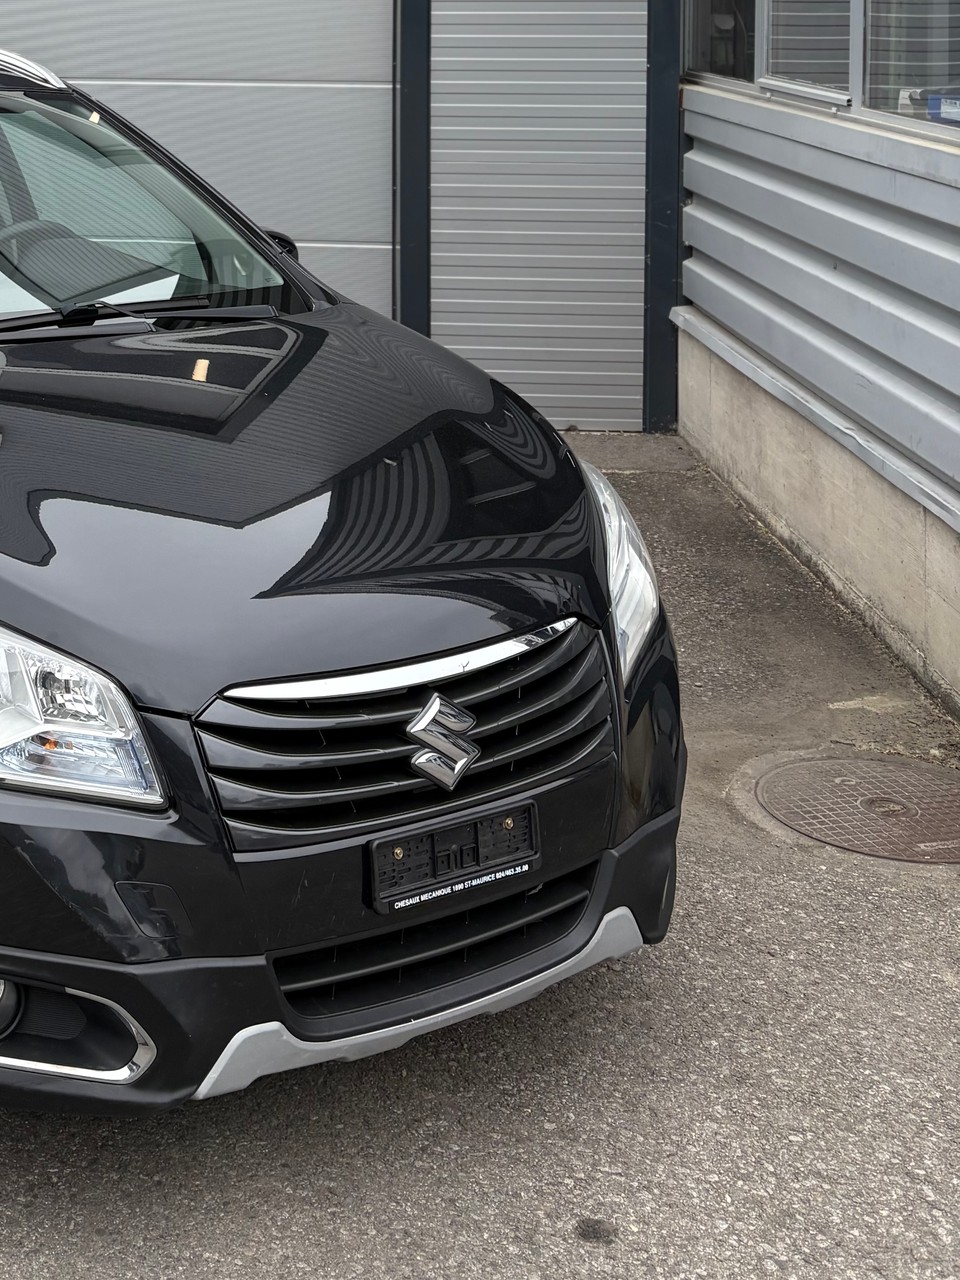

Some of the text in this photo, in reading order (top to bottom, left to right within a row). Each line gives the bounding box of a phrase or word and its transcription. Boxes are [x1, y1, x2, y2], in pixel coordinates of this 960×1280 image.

[394, 894, 420, 910] CHESAUX
[420, 885, 452, 902] MECANIQUE
[464, 873, 496, 889] ST-MAURICE
